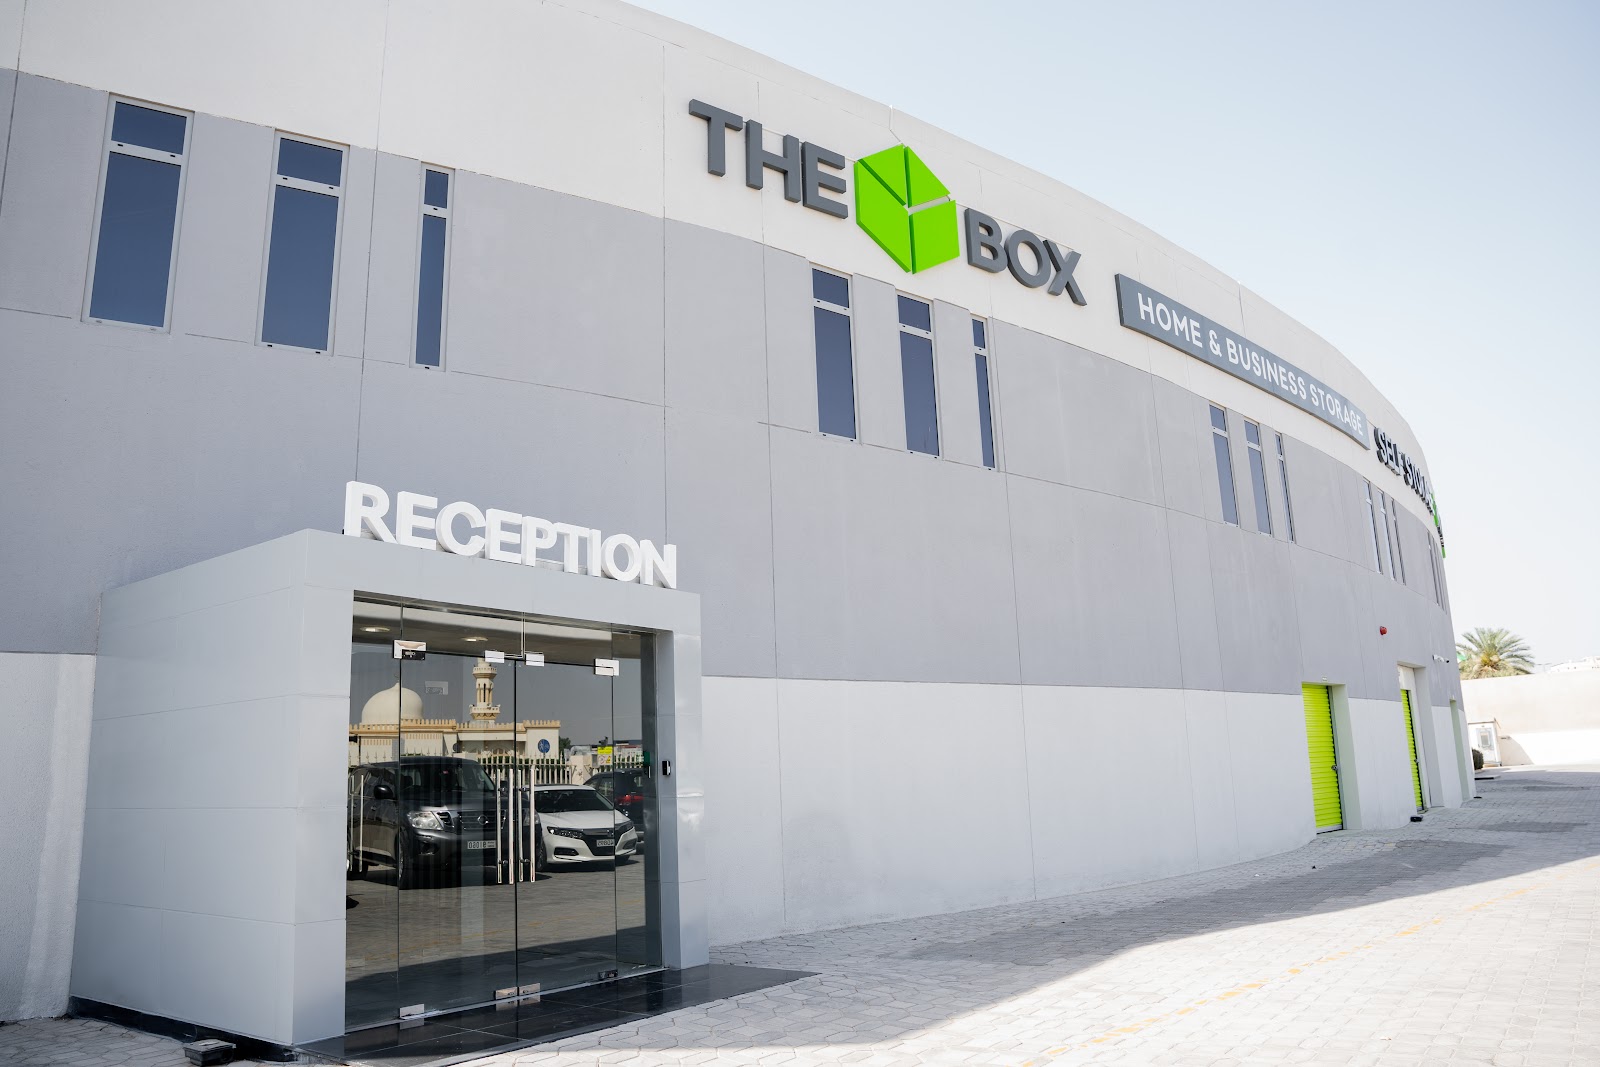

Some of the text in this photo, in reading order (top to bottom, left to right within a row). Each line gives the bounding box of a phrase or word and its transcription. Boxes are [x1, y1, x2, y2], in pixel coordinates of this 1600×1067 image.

[689, 99, 1087, 306] THE BOX
[1137, 292, 1364, 436] HOME & BUSINESS STORAGE
[344, 480, 677, 589] RECEPTION
